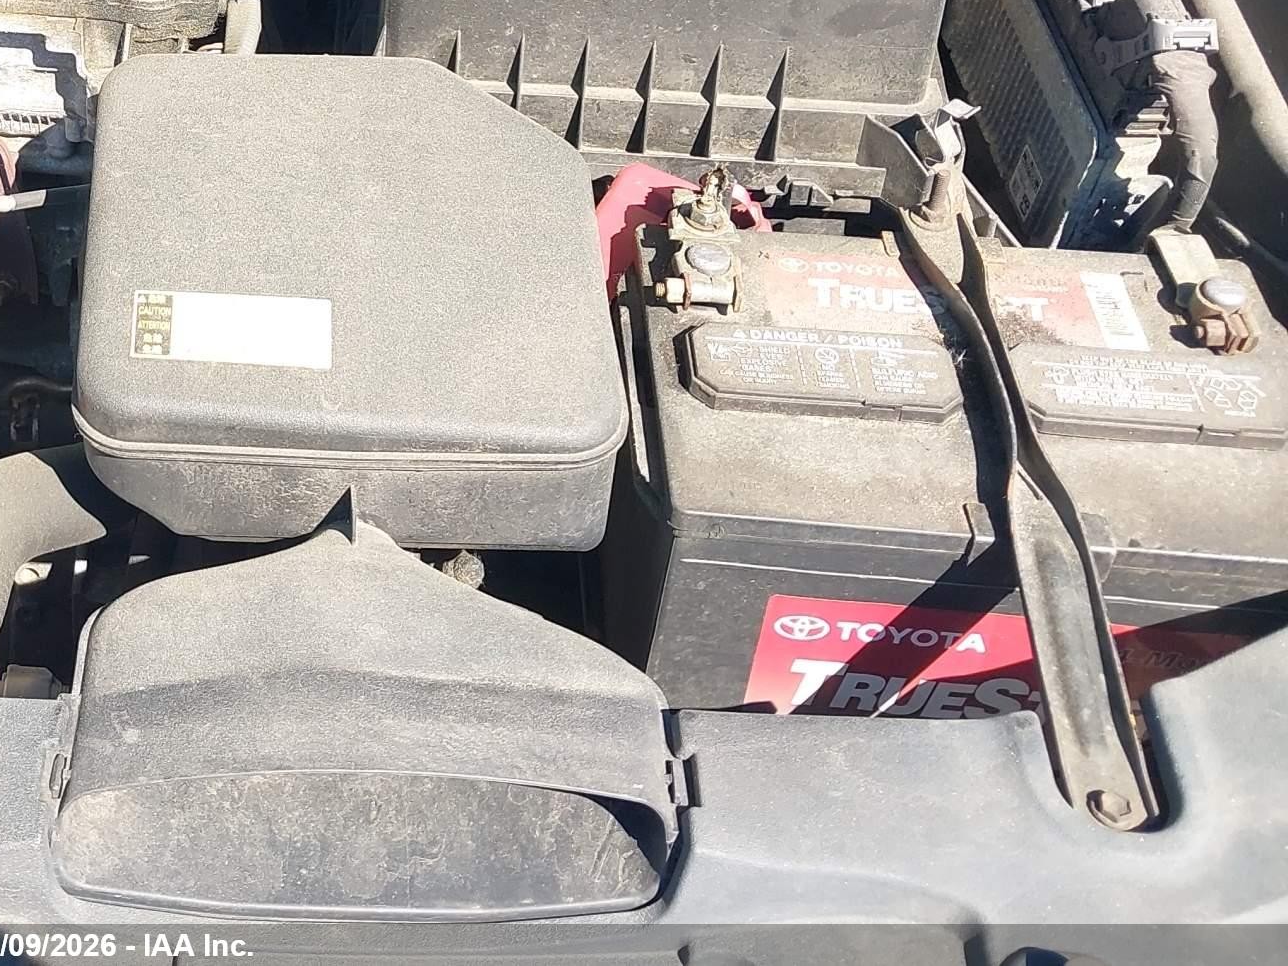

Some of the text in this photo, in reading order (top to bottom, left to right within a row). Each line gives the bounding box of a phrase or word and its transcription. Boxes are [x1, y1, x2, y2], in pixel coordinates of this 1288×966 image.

[814, 261, 900, 277] TOYOTA
[139, 305, 172, 316] CAUTION
[138, 320, 171, 331] ATTENTION
[749, 329, 819, 344] DANGER
[837, 335, 904, 349] POISON
[836, 621, 986, 654] TOYOTA
[789, 658, 1042, 720] TRUES
